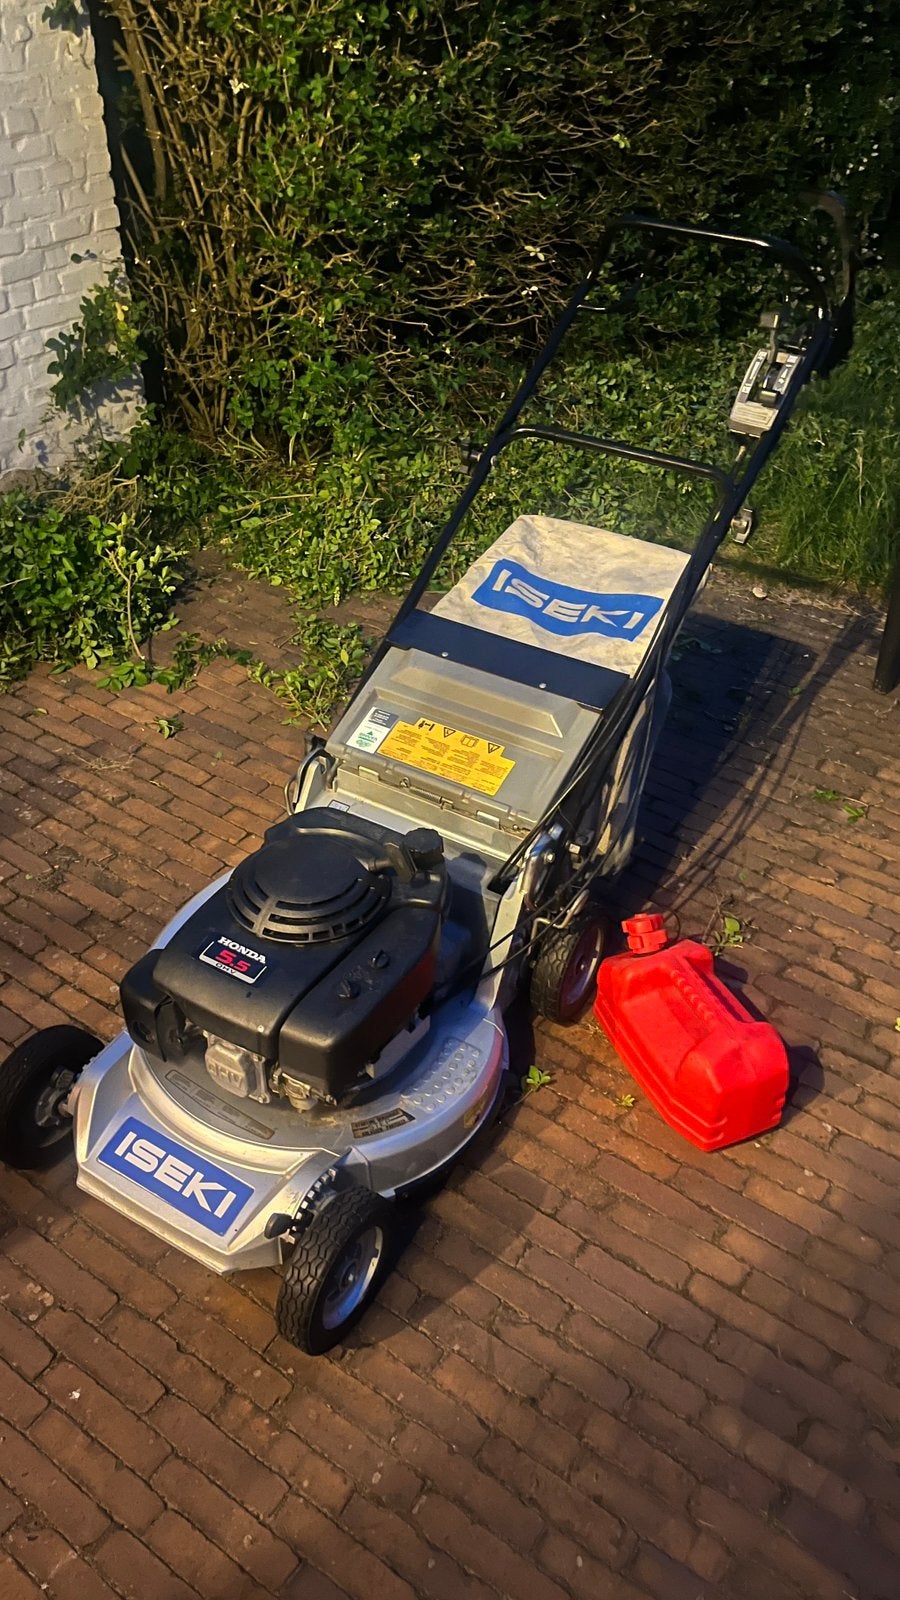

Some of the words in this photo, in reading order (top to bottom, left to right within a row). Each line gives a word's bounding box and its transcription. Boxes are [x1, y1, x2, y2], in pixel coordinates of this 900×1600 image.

[492, 569, 644, 629] ISEKI
[215, 949, 251, 972] 5.5
[218, 936, 266, 964] HONDA
[114, 1131, 237, 1219] ISEKI
